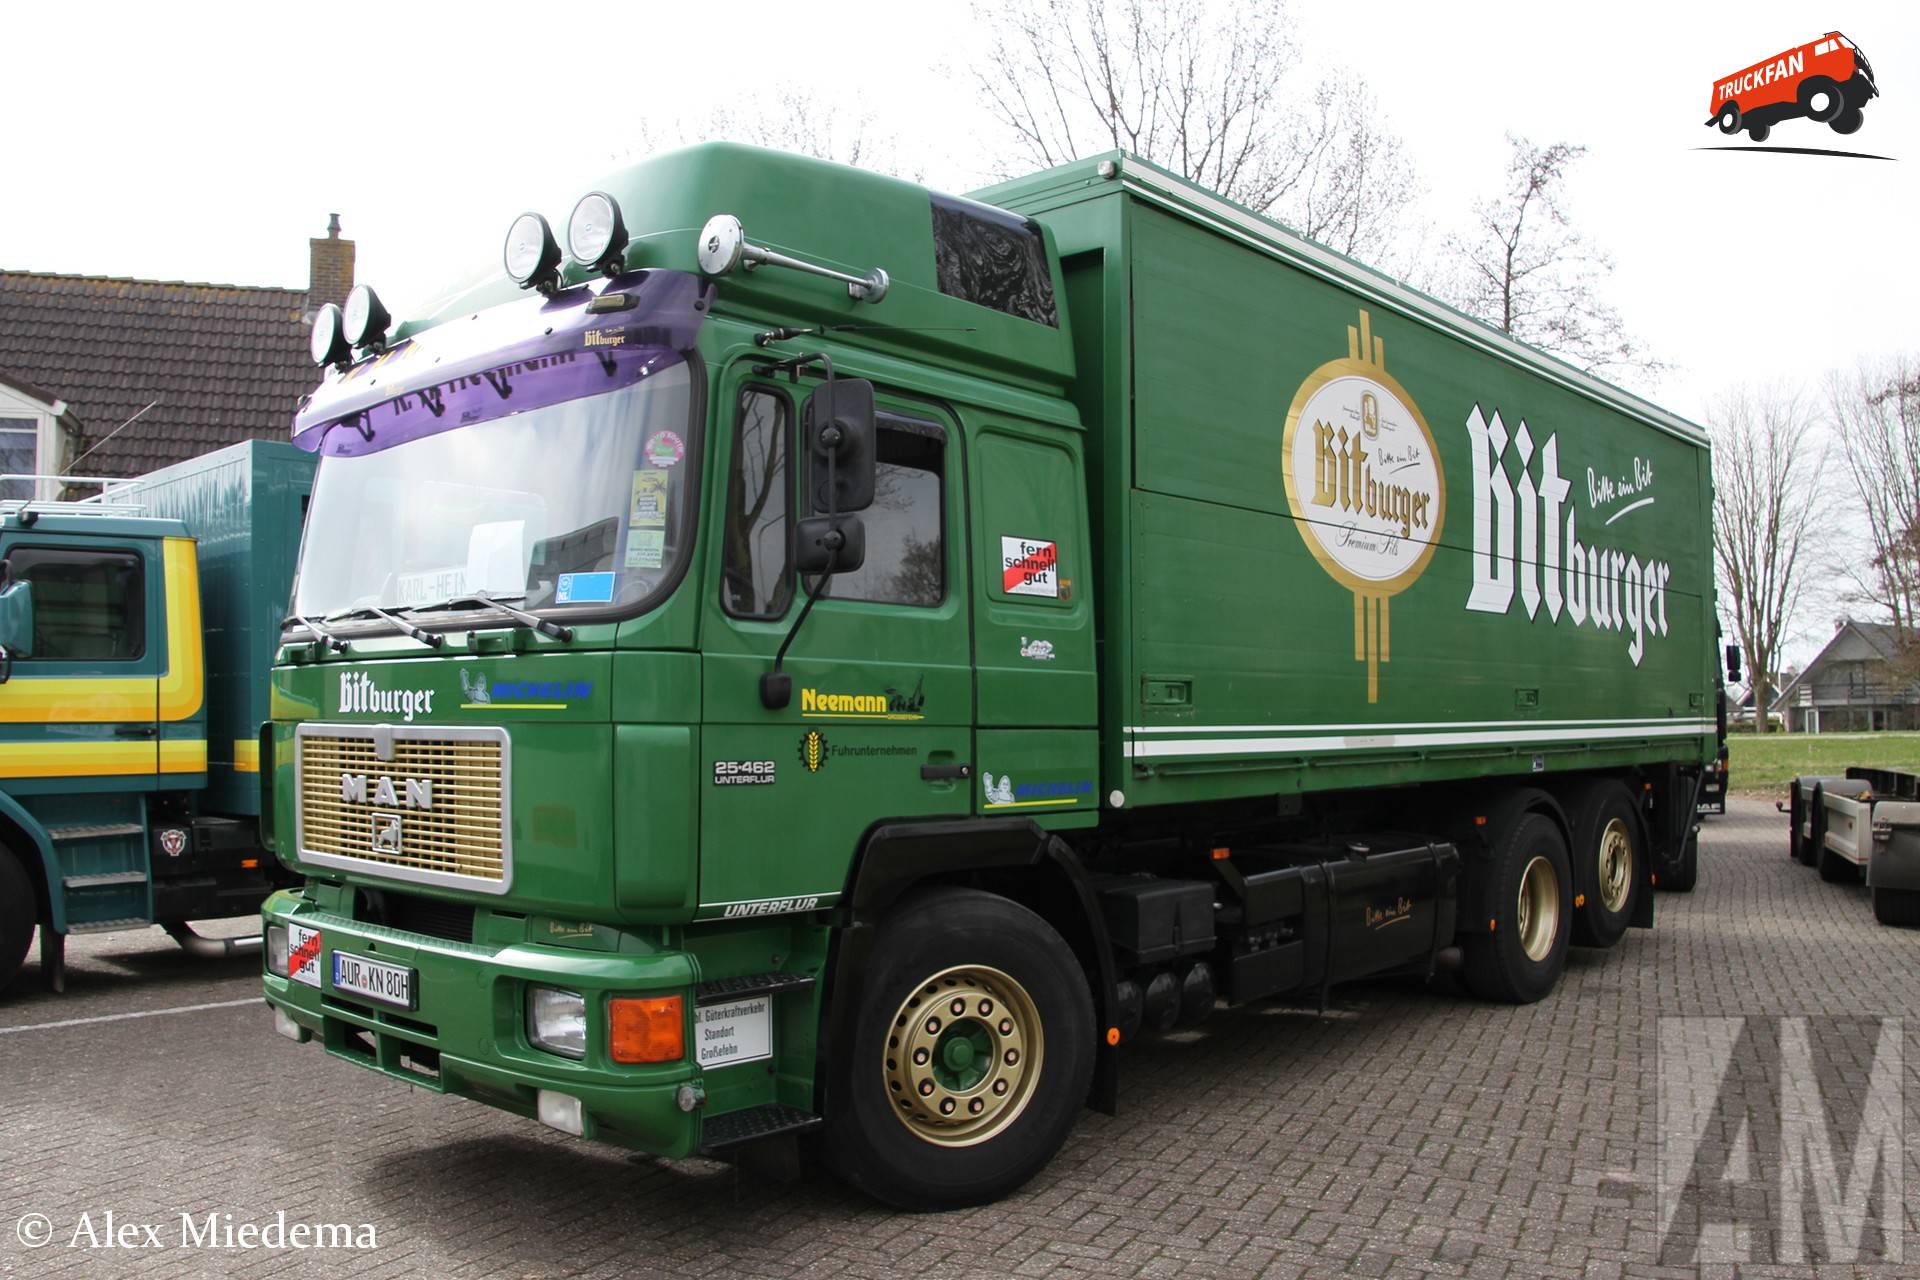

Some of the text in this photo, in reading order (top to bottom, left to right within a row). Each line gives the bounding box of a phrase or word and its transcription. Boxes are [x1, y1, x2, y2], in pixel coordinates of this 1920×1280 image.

[584, 330, 626, 347] Bitburger
[1311, 418, 1430, 539] Bitburger
[1335, 521, 1377, 552] Premium
[1465, 401, 1670, 668] Bitburger
[1020, 541, 1053, 558] fern
[1005, 556, 1056, 573] schnell
[1023, 572, 1048, 586] gut
[338, 671, 435, 722] Bitburger
[801, 688, 887, 713] Neemann
[831, 744, 918, 757] Fuhrunternehmen
[714, 774, 776, 784] UNTERFLUR
[341, 773, 433, 809] MAN
[724, 897, 819, 918] UNTERFLUR
[298, 929, 319, 946] fern
[289, 943, 321, 962] schnell
[299, 959, 315, 974] gut
[341, 959, 410, 1001] AUR KN 80H
[705, 1001, 765, 1022] Güterkraftverkehr
[704, 1026, 735, 1041] Standort
